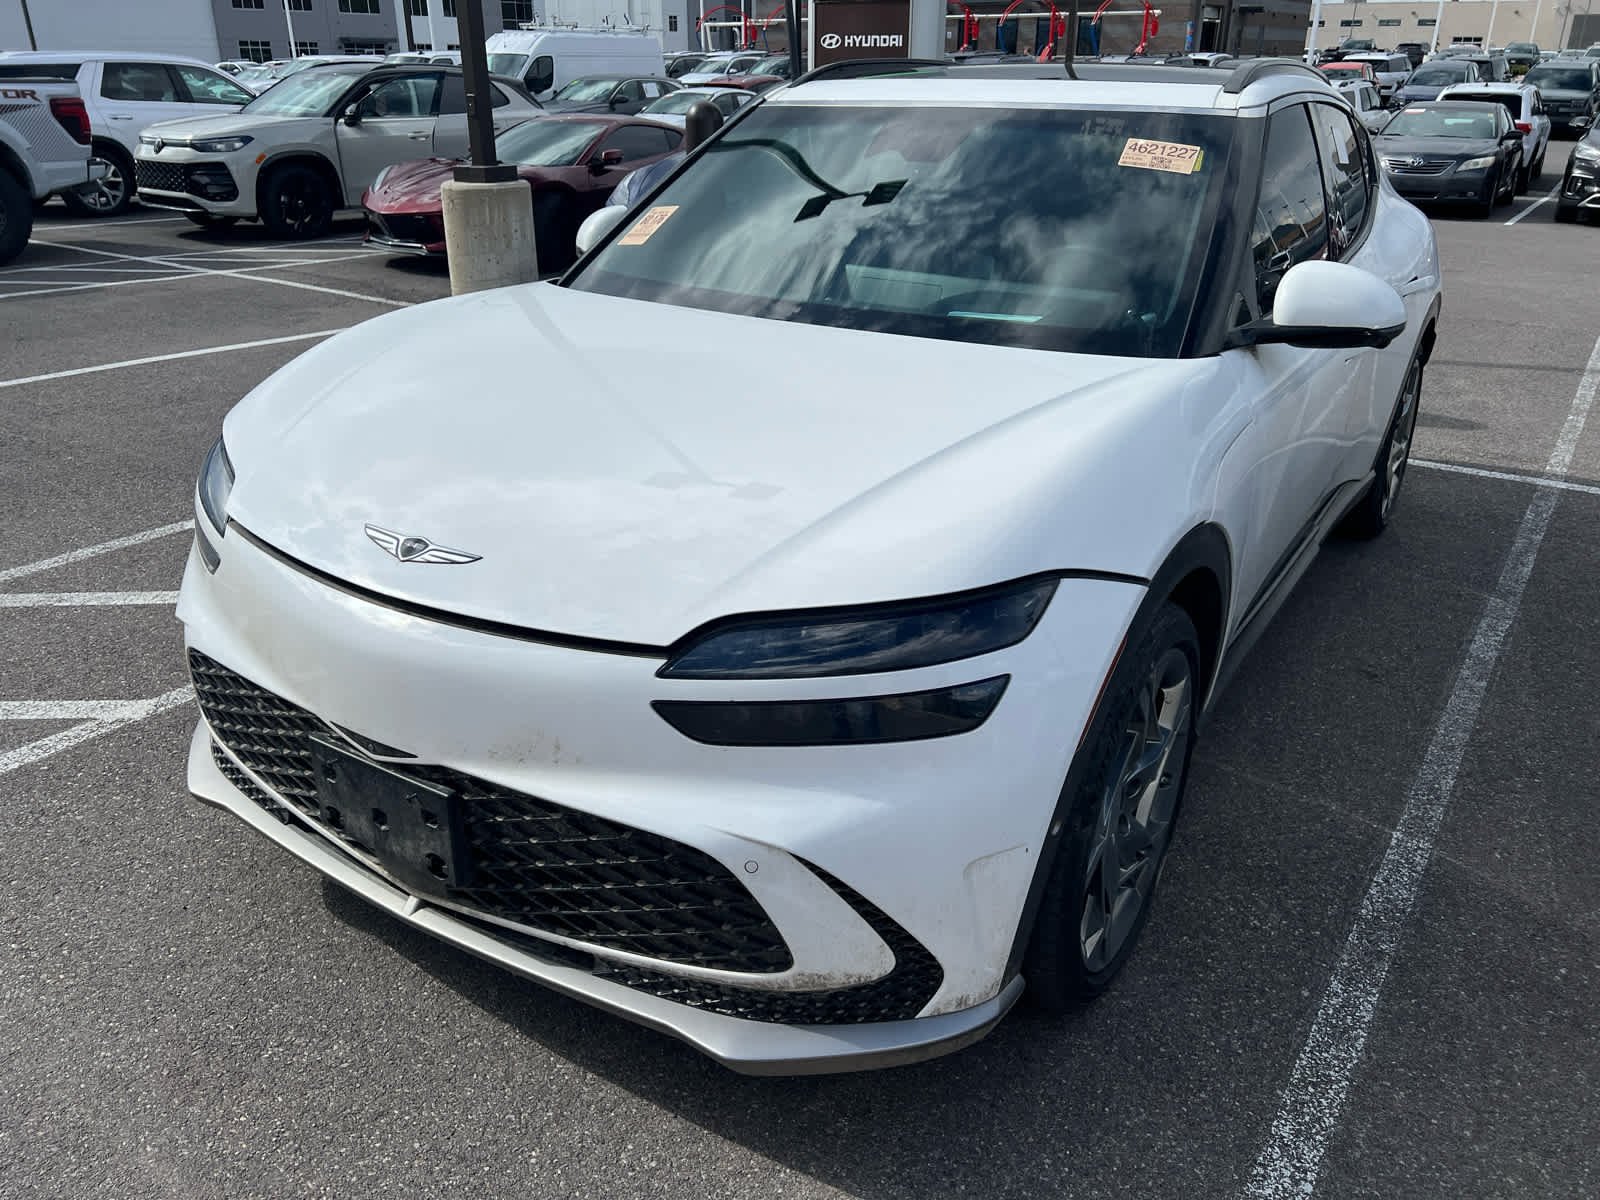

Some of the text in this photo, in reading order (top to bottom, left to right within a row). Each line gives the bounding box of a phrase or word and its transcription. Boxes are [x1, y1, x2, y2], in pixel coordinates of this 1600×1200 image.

[844, 35, 903, 47] HYUNDAI
[0, 88, 42, 102] OR
[1128, 142, 1198, 160] 4621227
